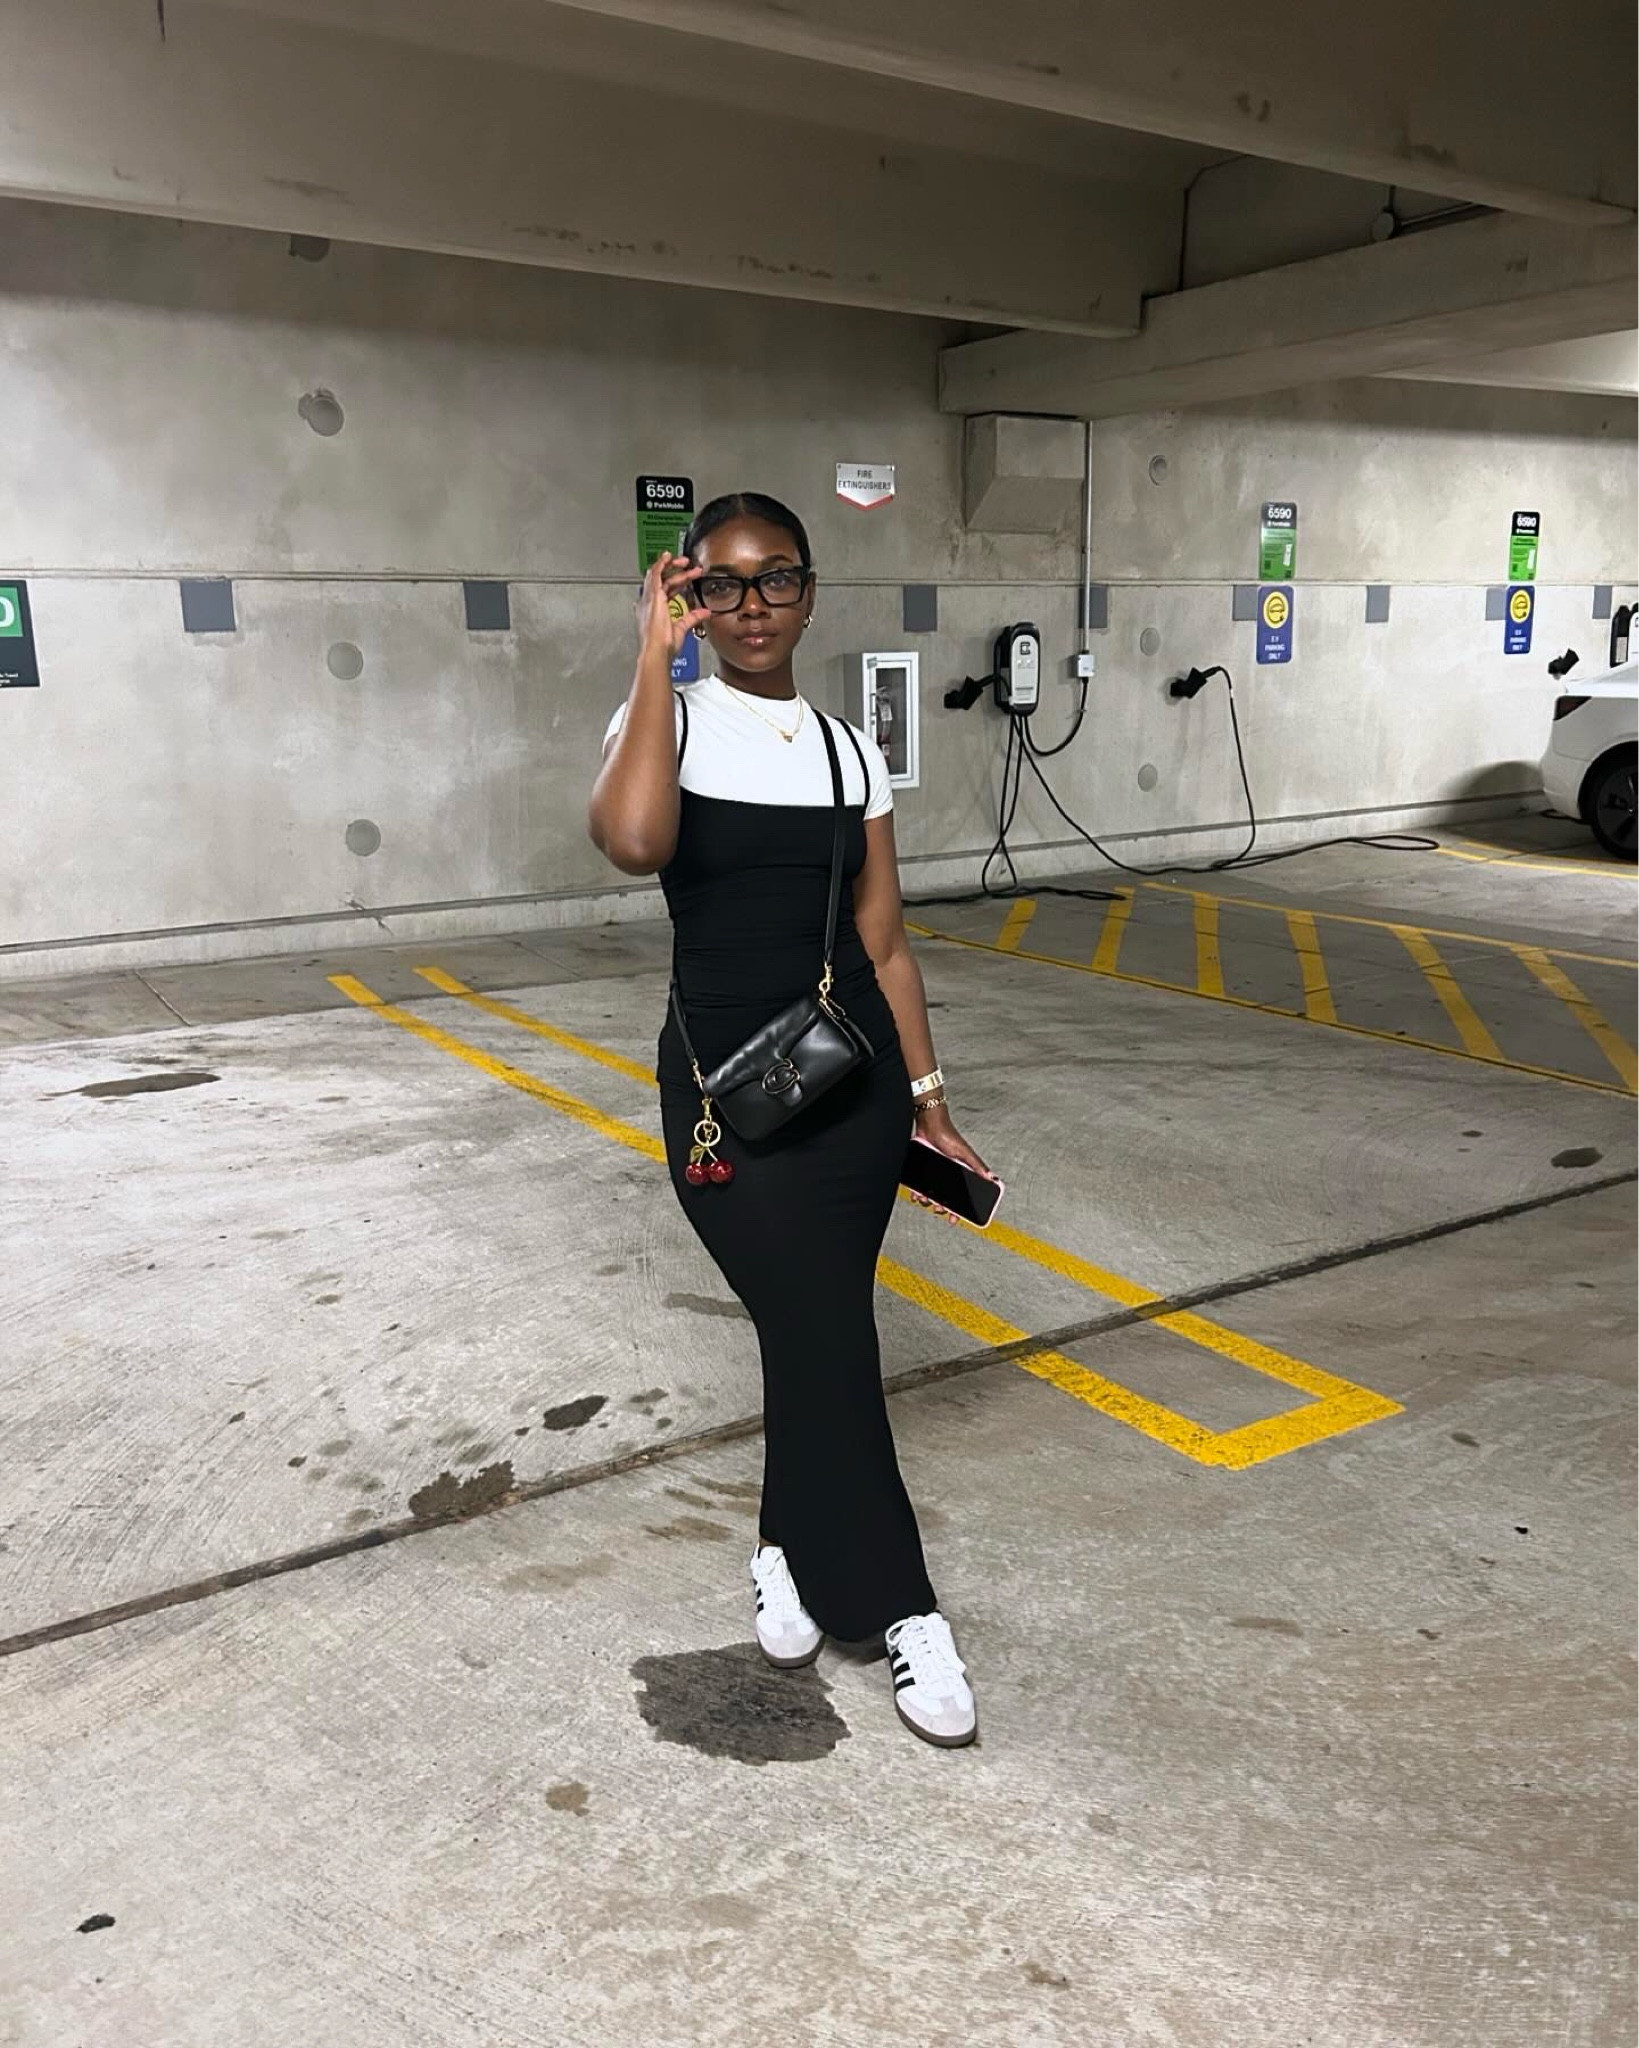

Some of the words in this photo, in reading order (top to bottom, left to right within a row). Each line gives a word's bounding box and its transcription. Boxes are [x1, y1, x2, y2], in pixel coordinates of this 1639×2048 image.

[857, 470, 873, 479] FIRE
[646, 484, 685, 499] 6590
[1268, 507, 1292, 519] 6590
